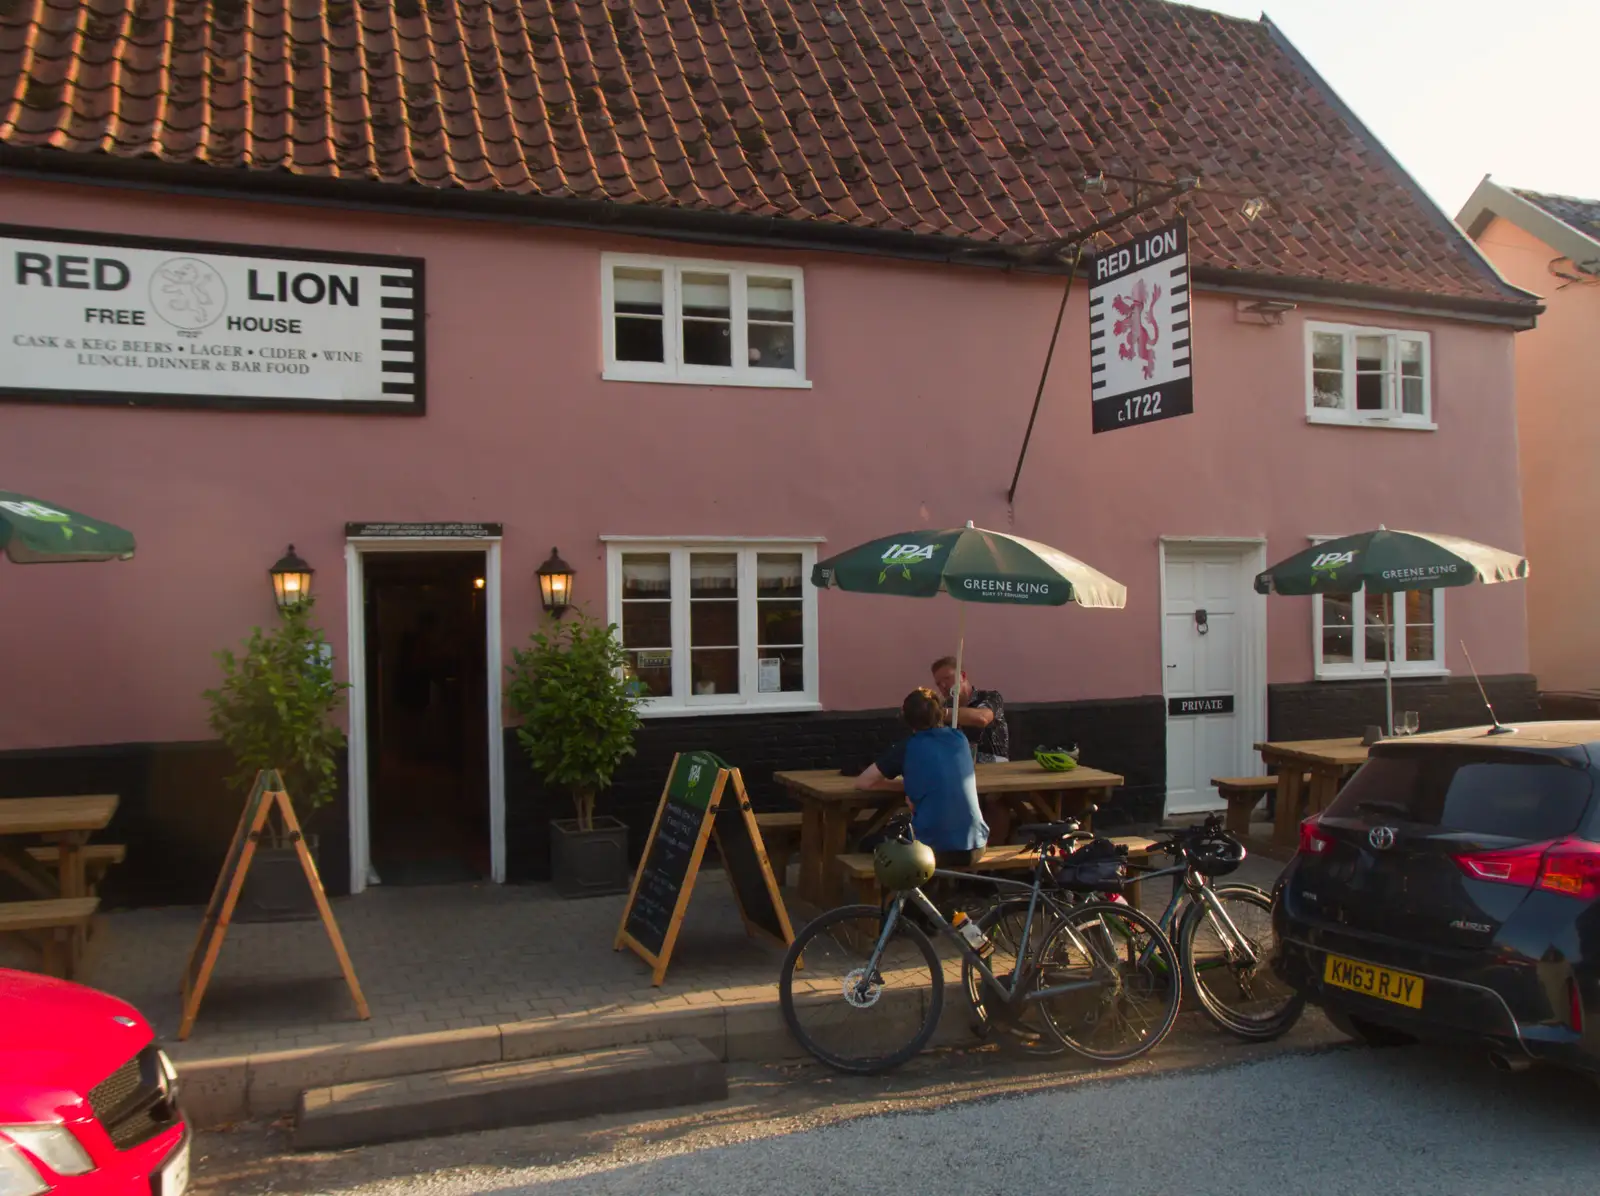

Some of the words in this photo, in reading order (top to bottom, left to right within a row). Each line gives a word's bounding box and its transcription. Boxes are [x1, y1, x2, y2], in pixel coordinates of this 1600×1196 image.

[1097, 249, 1131, 280] RED
[1135, 228, 1178, 265] LION
[14, 251, 131, 292] RED
[247, 269, 360, 306] LION
[84, 308, 146, 325] FREE
[226, 316, 303, 334] HOUSE
[12, 334, 60, 348] CASK
[64, 339, 77, 349] &
[82, 338, 117, 351] KEG
[122, 340, 173, 353] BEERS
[190, 343, 243, 357] LAGER
[259, 346, 308, 360] CIDER
[323, 350, 363, 363] WINE
[146, 357, 211, 371] DINNER
[215, 362, 227, 371] &
[231, 361, 262, 373] BAR
[266, 363, 310, 375] FOOD
[880, 544, 934, 559] IPA
[1311, 551, 1353, 567] IPA
[1382, 567, 1425, 579] GREENE
[1428, 564, 1457, 575] KING
[963, 579, 1012, 591] GREENE
[1016, 582, 1049, 594] KING
[1181, 700, 1223, 711] PRIVATE
[1450, 920, 1491, 932] AURIS
[1331, 960, 1376, 990] KM63
[1378, 971, 1416, 1002] RJY
